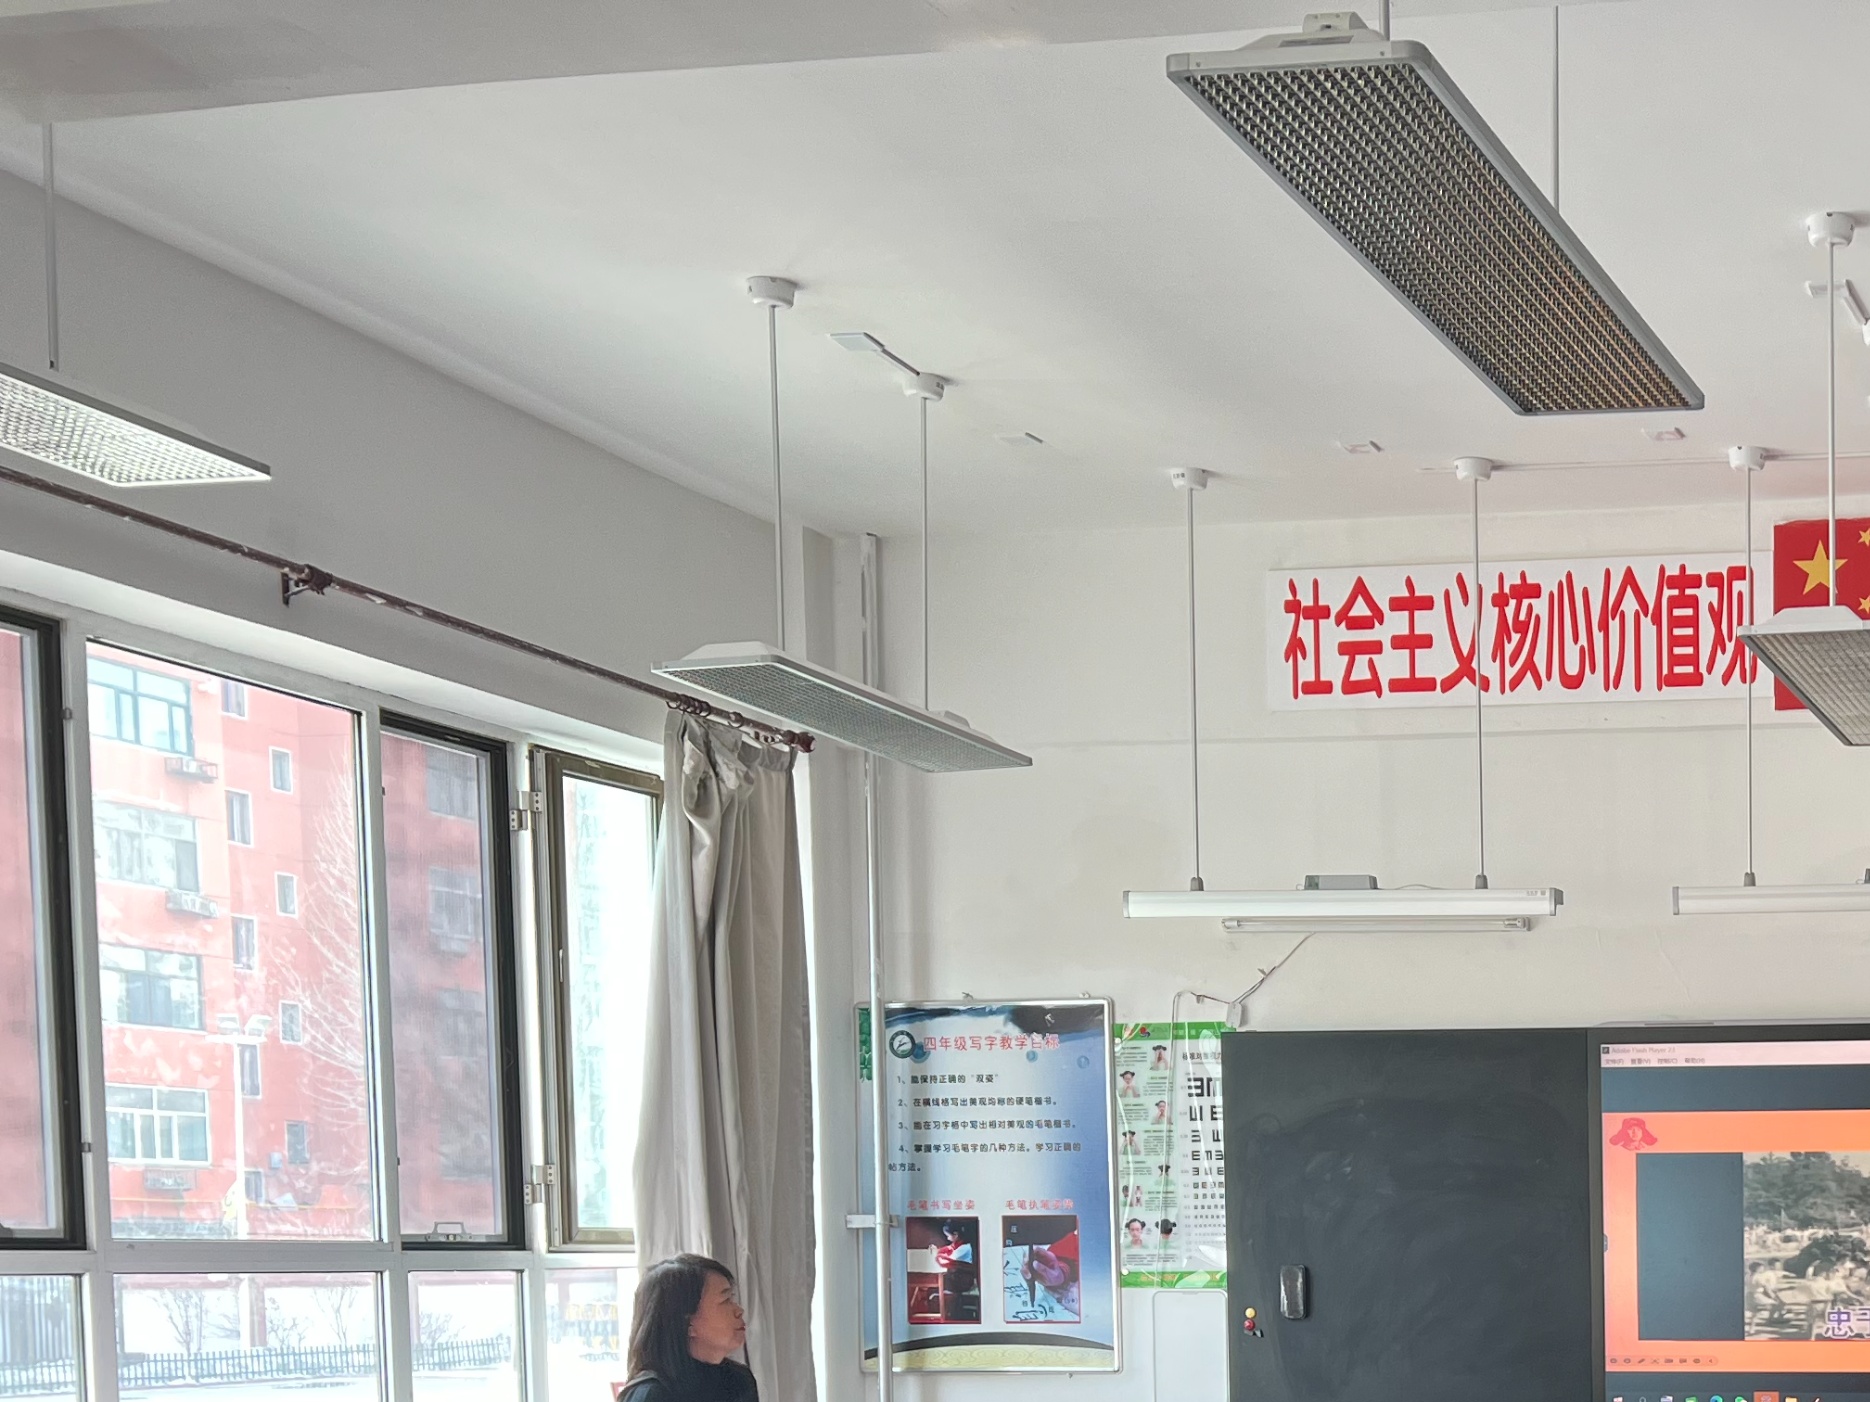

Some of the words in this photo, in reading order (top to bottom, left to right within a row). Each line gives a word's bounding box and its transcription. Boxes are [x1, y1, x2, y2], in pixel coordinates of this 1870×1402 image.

[1282, 562, 1758, 700] 社会主义核心价值观
